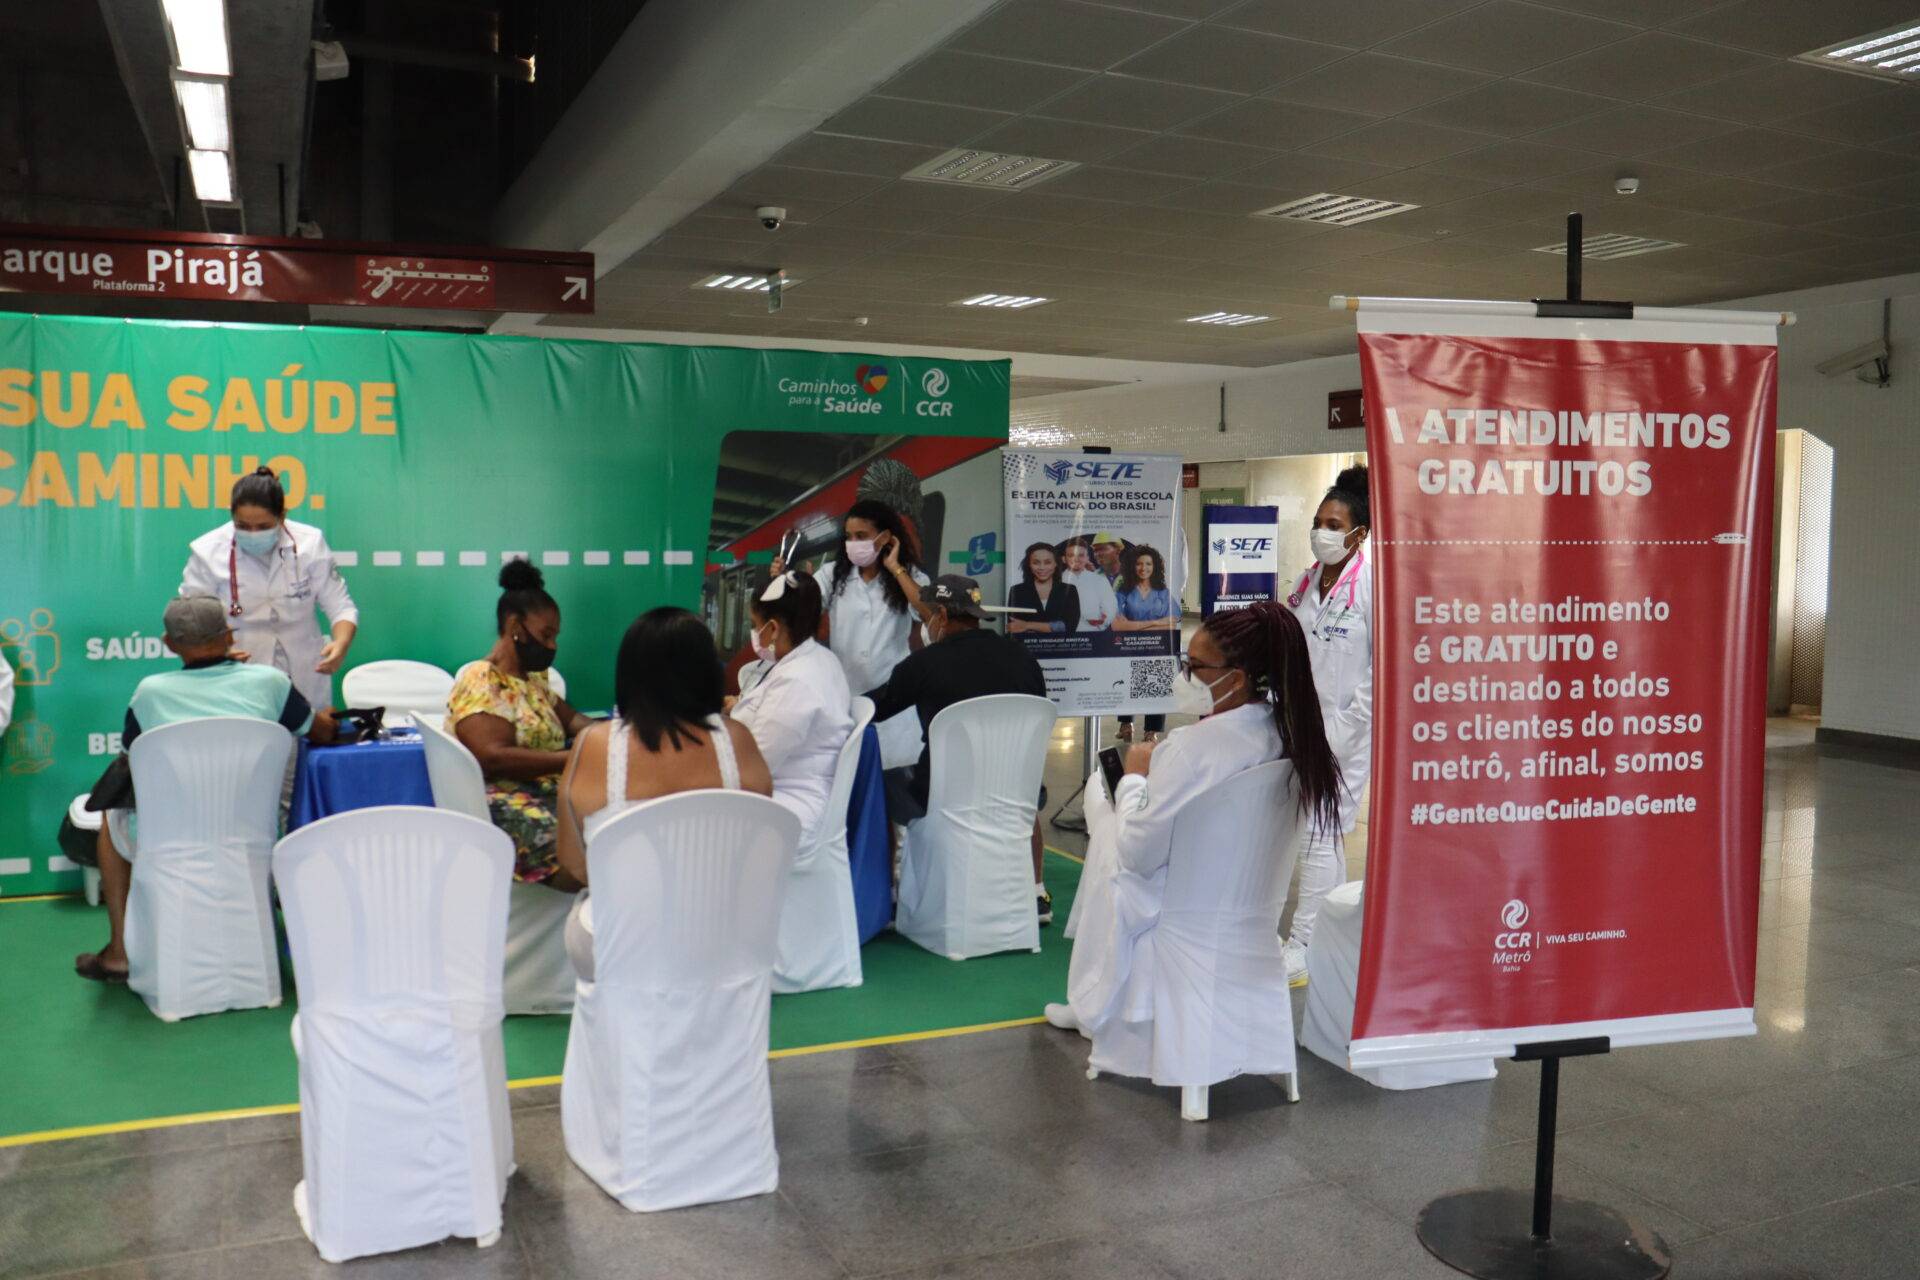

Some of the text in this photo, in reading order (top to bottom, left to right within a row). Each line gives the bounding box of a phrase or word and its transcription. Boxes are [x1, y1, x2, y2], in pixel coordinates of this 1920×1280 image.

[3, 248, 264, 295] arque Pirajá
[93, 279, 166, 292] Plataforma 2
[778, 377, 857, 396] Caminhos
[0, 364, 397, 436] SUA SAÚDE
[789, 395, 813, 406] para
[823, 398, 882, 415] Saúde
[915, 400, 953, 417] CCR
[1416, 408, 1731, 449] ATENDIMENTOS
[1417, 458, 1652, 496] GRATUITOS
[1058, 491, 1068, 499] A
[1071, 491, 1123, 500] MELHOR
[1126, 491, 1174, 500] ESCOLA
[1088, 501, 1107, 510] DO
[1110, 501, 1156, 511] BRASIL!
[1414, 596, 1670, 624] Este atendimento
[1413, 634, 1618, 663] é GRATUITO e
[1413, 671, 1670, 703] destinado a todos
[1412, 710, 1702, 742] os clientes do nosso
[88, 732, 123, 756] BE
[1412, 748, 1703, 782] metrô, afinal, somos
[1411, 794, 1697, 825] #GenteQueCuidaDeGente
[1494, 932, 1532, 949] CCR
[1546, 929, 1627, 944] VIVA SEU CAMINHO.
[1492, 950, 1531, 965] Metrô
[1502, 965, 1521, 973] Bahia
